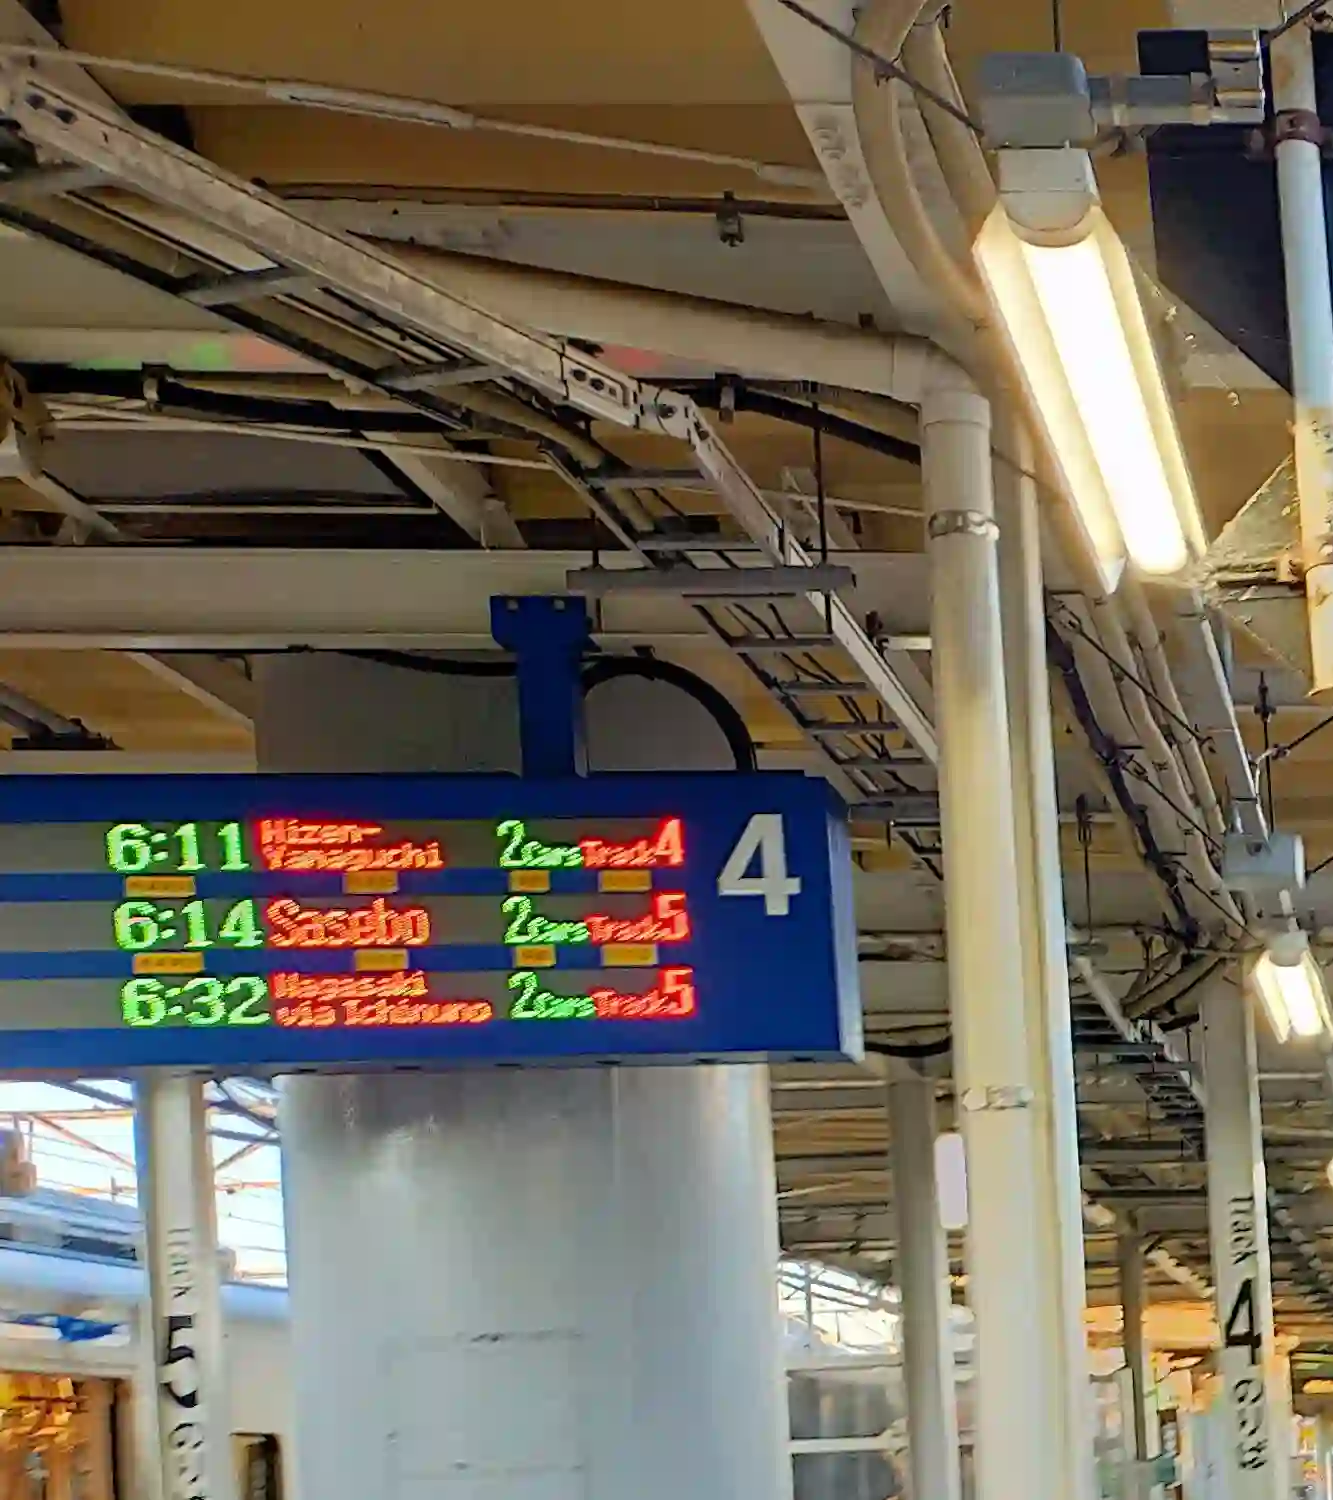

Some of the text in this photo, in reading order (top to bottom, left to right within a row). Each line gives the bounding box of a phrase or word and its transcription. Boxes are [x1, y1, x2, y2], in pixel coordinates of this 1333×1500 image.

[106, 823, 252, 872] 6:11
[718, 814, 801, 916] 4
[113, 899, 265, 949] 6:14
[265, 898, 432, 947] Sasebo
[119, 976, 272, 1026] 6:32
[1225, 1278, 1262, 1366] 4
[164, 1314, 200, 1409] 5
